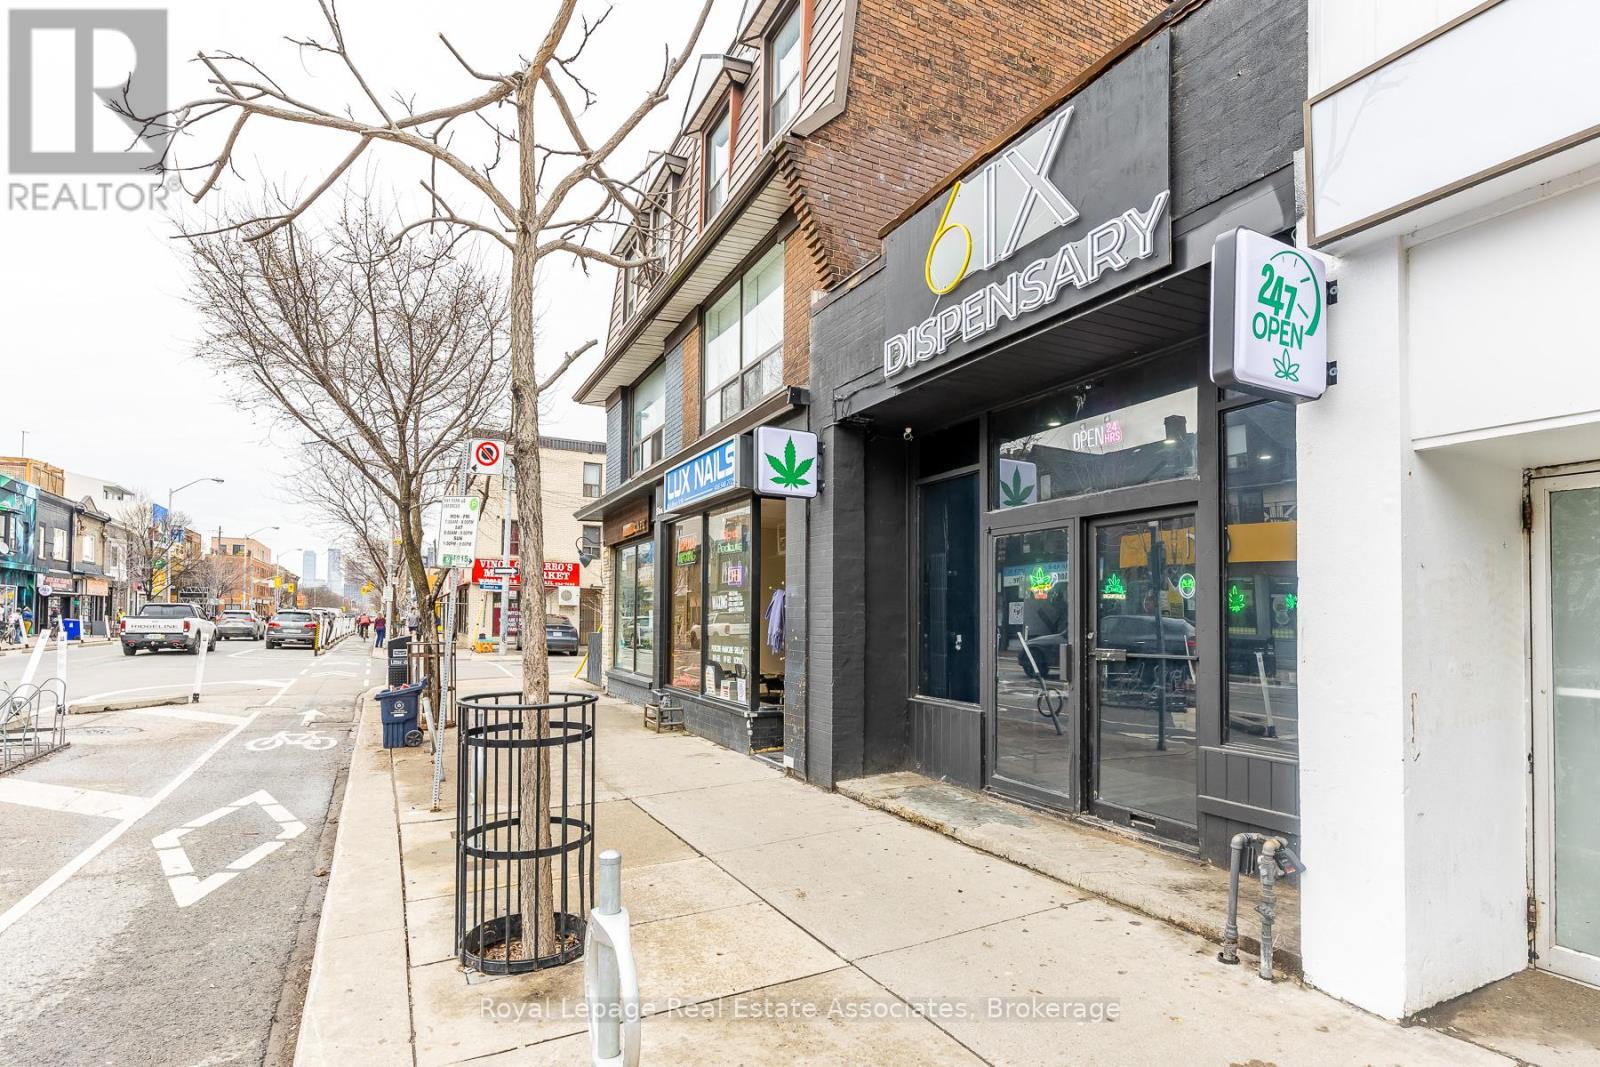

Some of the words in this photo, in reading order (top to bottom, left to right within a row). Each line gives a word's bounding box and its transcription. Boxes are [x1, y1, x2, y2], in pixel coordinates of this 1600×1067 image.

[924, 105, 1080, 295] 6IX
[884, 190, 1170, 377] DISPENSARY
[1252, 312, 1304, 350] OPEN
[1073, 426, 1104, 451] OPEN
[1104, 430, 1122, 445] HRS
[667, 465, 691, 500] LUX
[694, 442, 736, 490] NAILS
